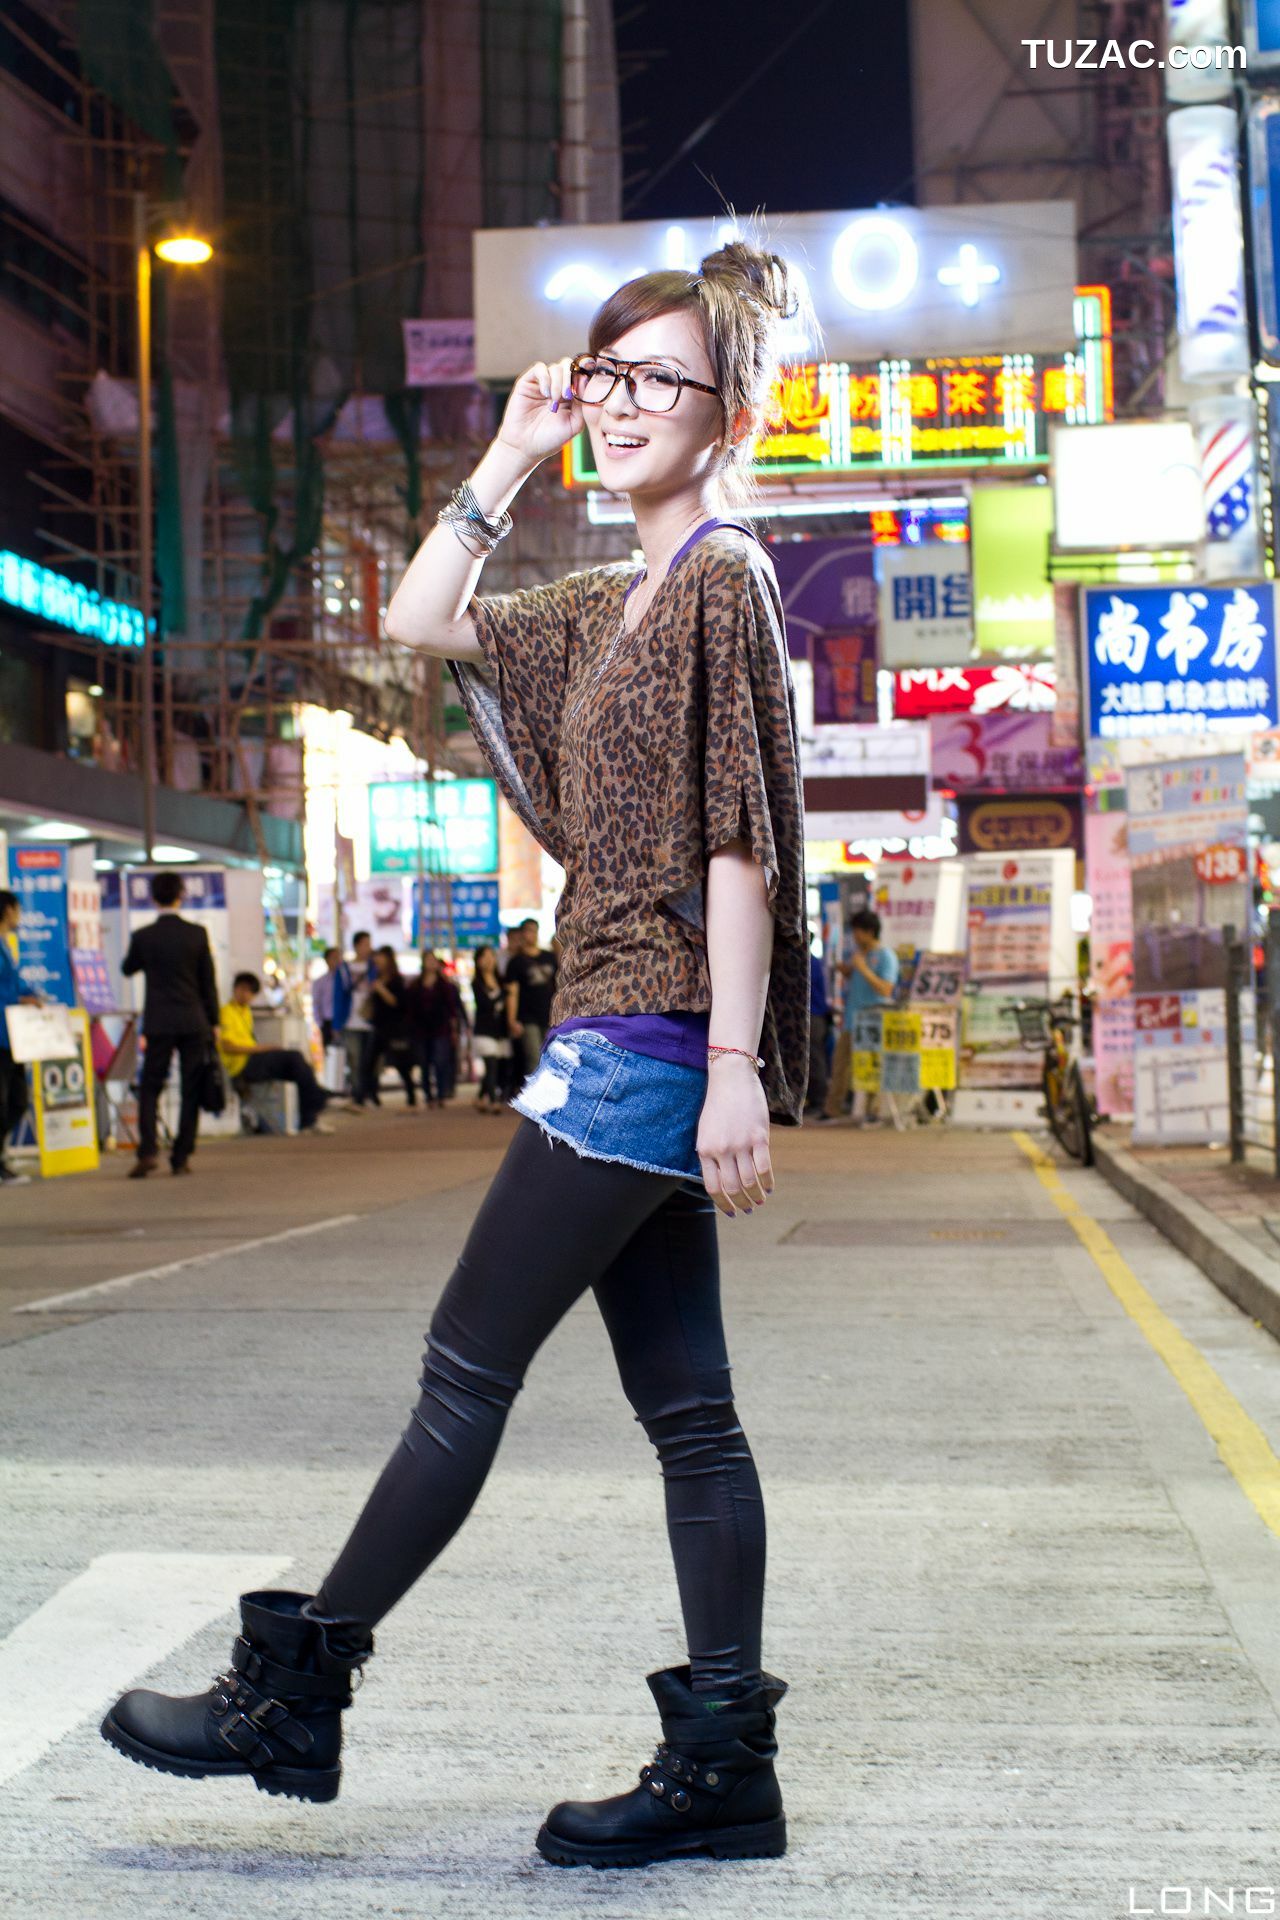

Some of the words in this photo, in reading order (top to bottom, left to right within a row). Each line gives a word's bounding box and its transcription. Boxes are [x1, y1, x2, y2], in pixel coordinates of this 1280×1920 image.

[1094, 587, 1268, 676] 尚书房
[917, 971, 961, 997] $75
